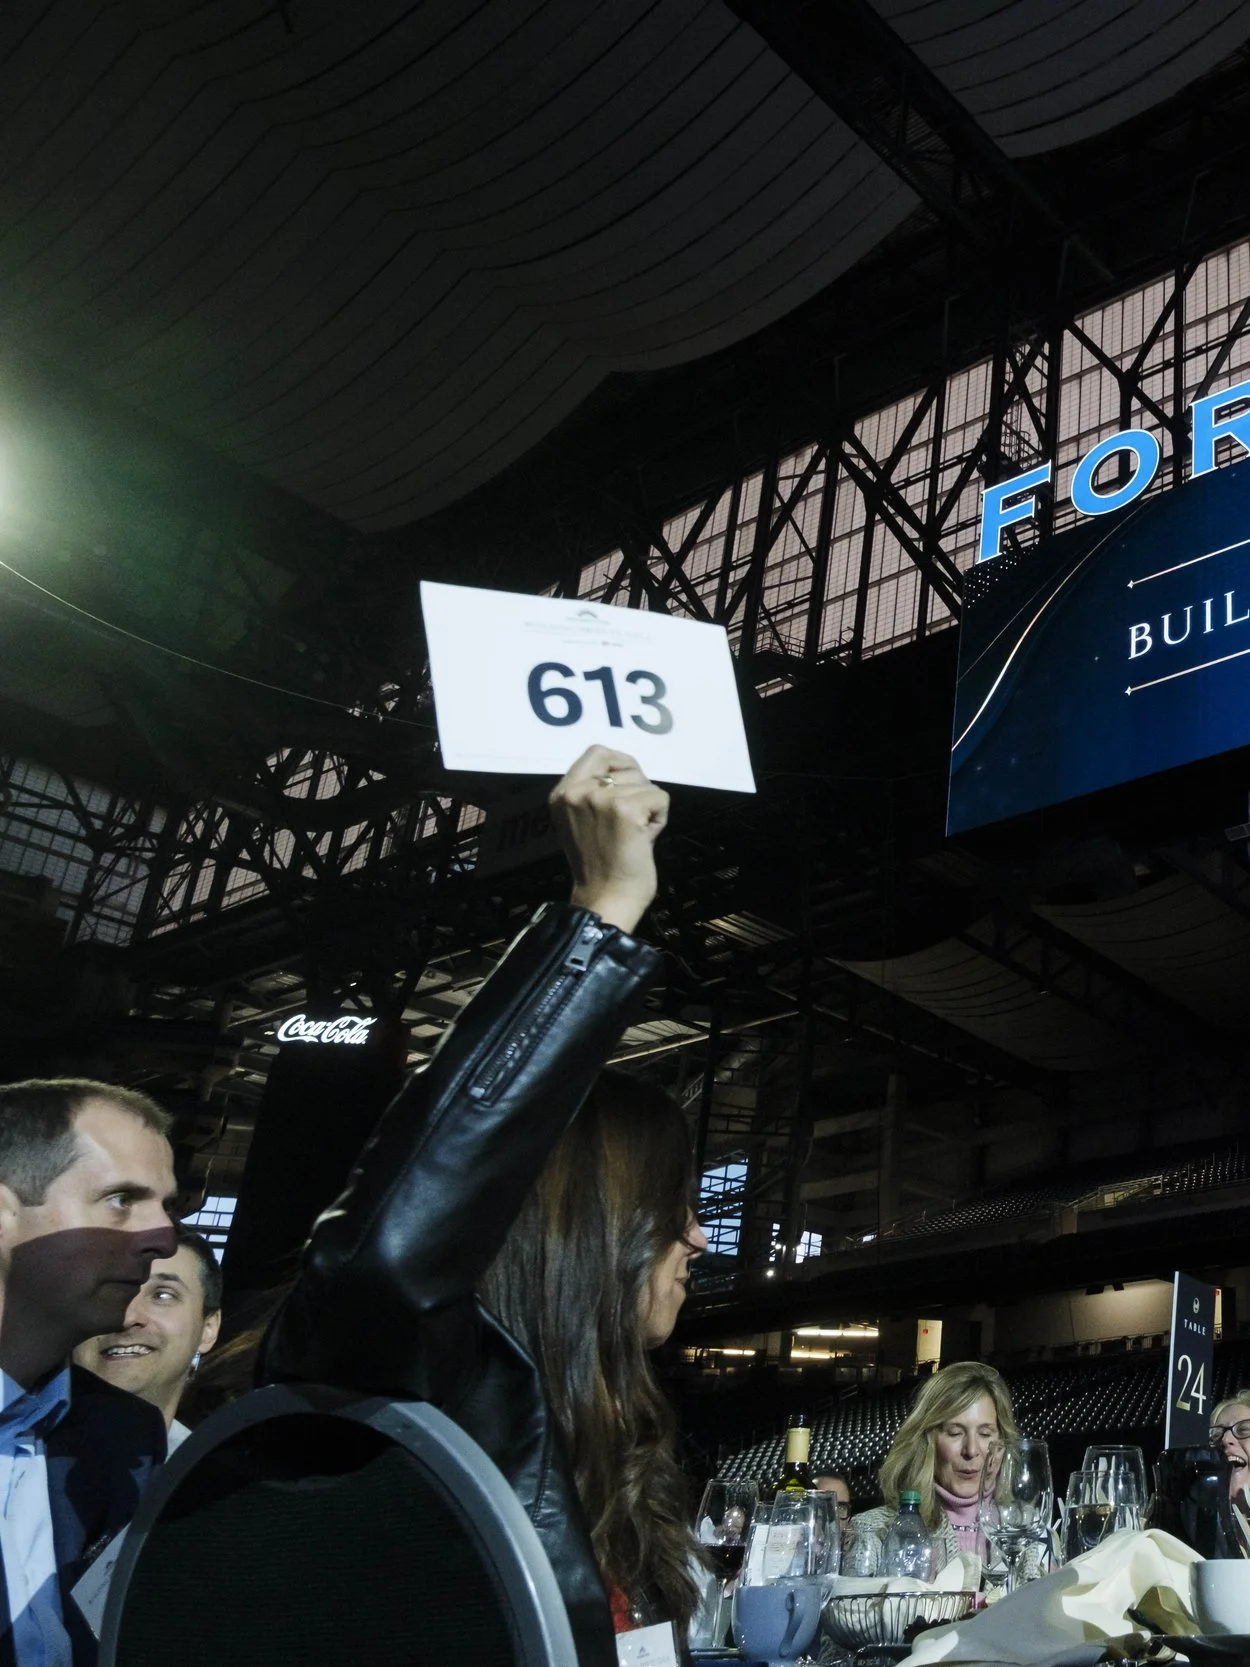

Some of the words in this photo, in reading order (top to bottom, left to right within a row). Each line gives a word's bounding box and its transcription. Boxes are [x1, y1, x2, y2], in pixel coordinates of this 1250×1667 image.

[526, 661, 675, 736] 613
[1183, 1318, 1206, 1336] TABLE
[1176, 1354, 1207, 1415] 24
